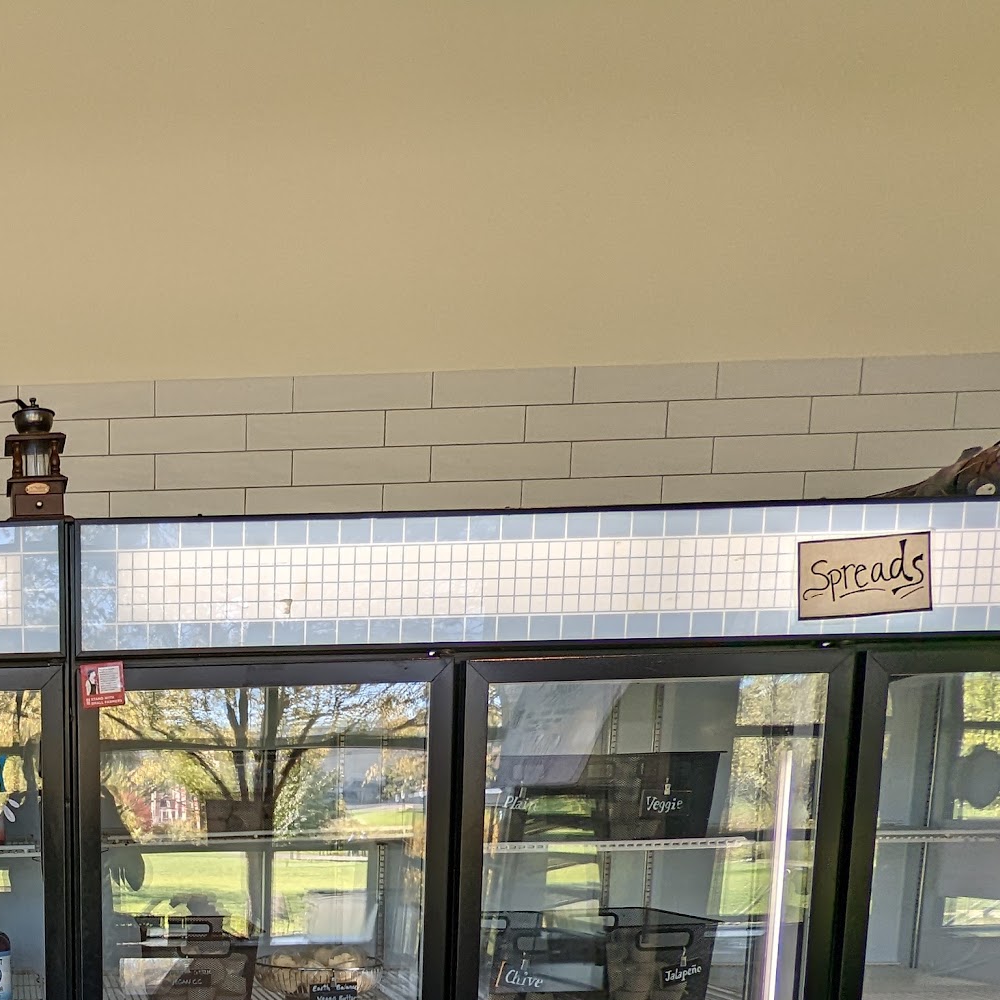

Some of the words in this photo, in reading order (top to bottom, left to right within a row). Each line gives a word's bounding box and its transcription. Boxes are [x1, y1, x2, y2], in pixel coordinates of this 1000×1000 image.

[803, 539, 924, 602] Spreads
[646, 796, 683, 813] Veggie
[505, 969, 544, 988] Chive
[664, 966, 702, 982] Jalapeño
